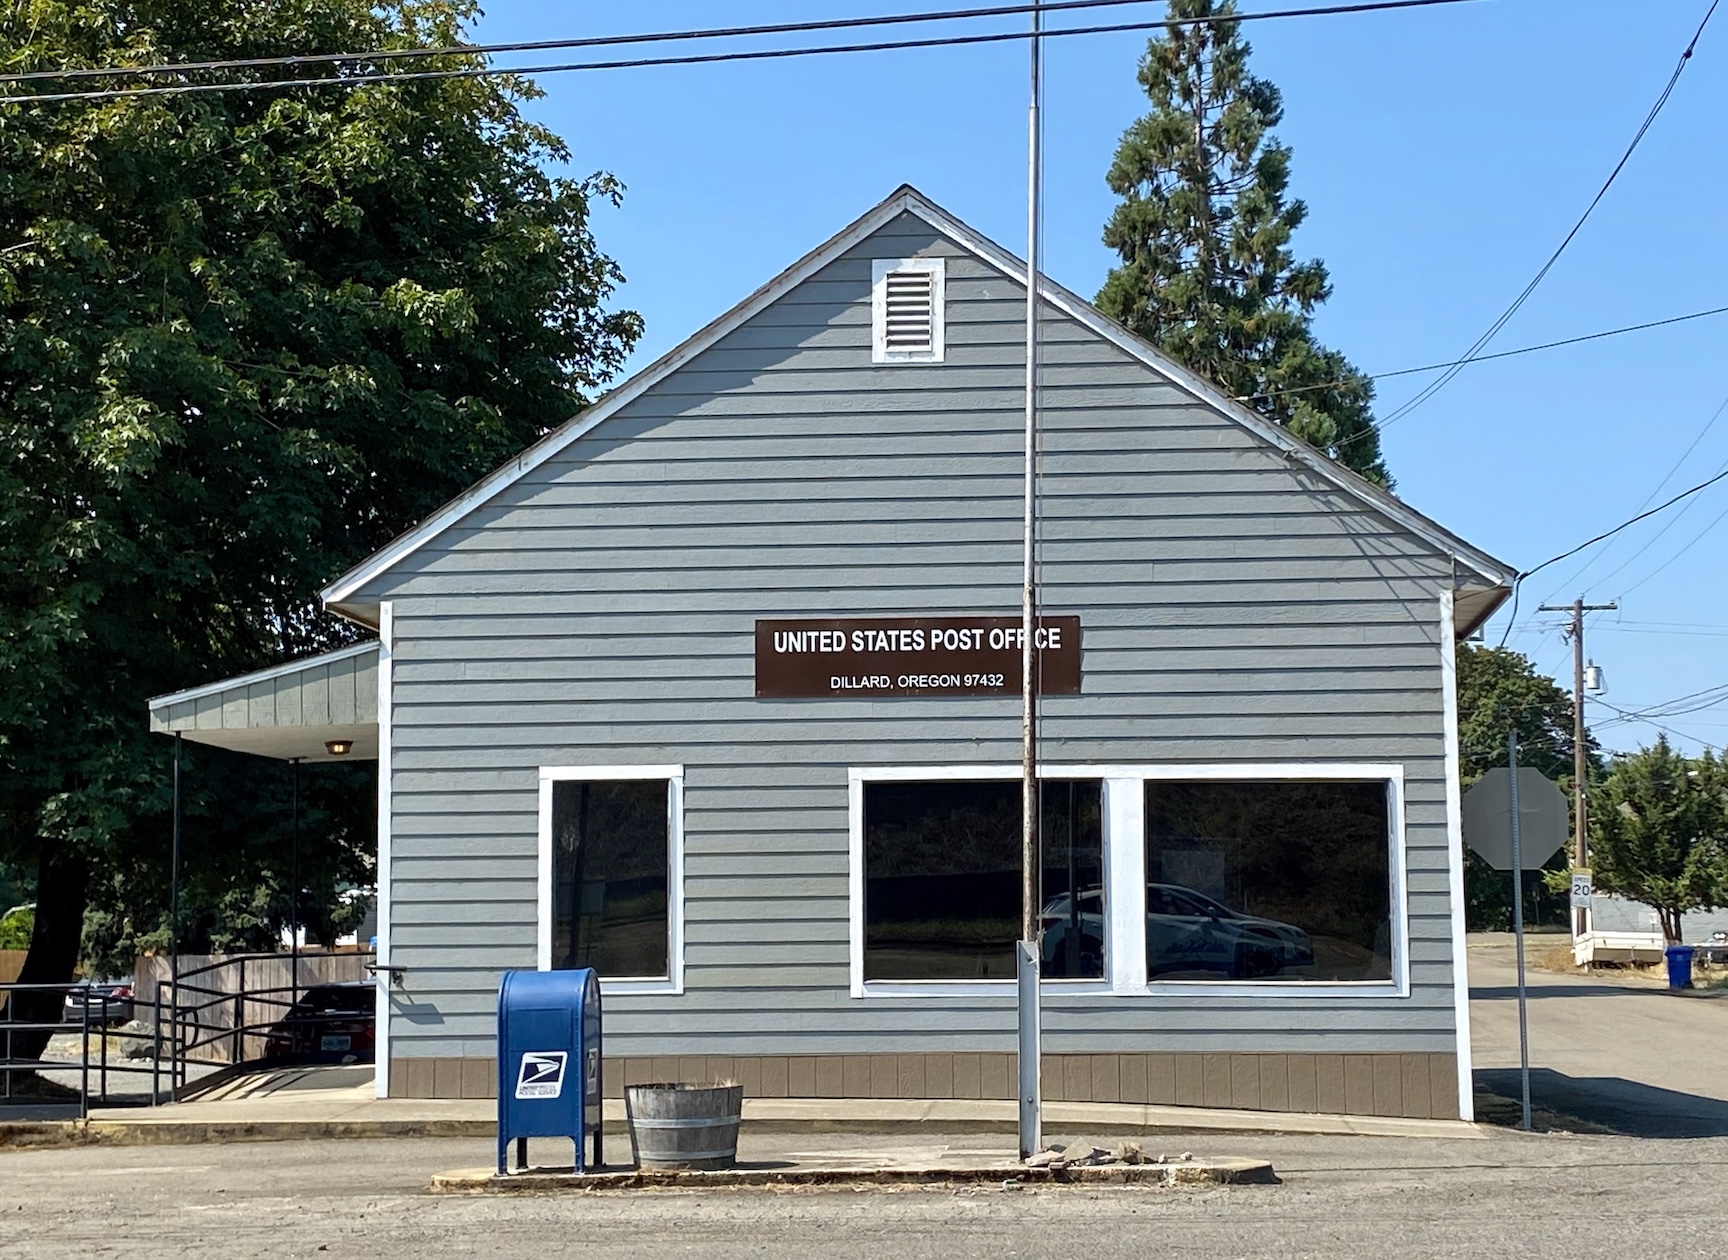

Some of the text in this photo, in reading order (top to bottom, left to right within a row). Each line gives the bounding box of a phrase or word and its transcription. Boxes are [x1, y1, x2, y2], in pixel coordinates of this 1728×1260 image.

[774, 628, 1062, 653] UNITED STATES POST OFFCE
[830, 673, 1004, 690] DILLARD, OREGON 97432
[1573, 884, 1590, 896] 20
